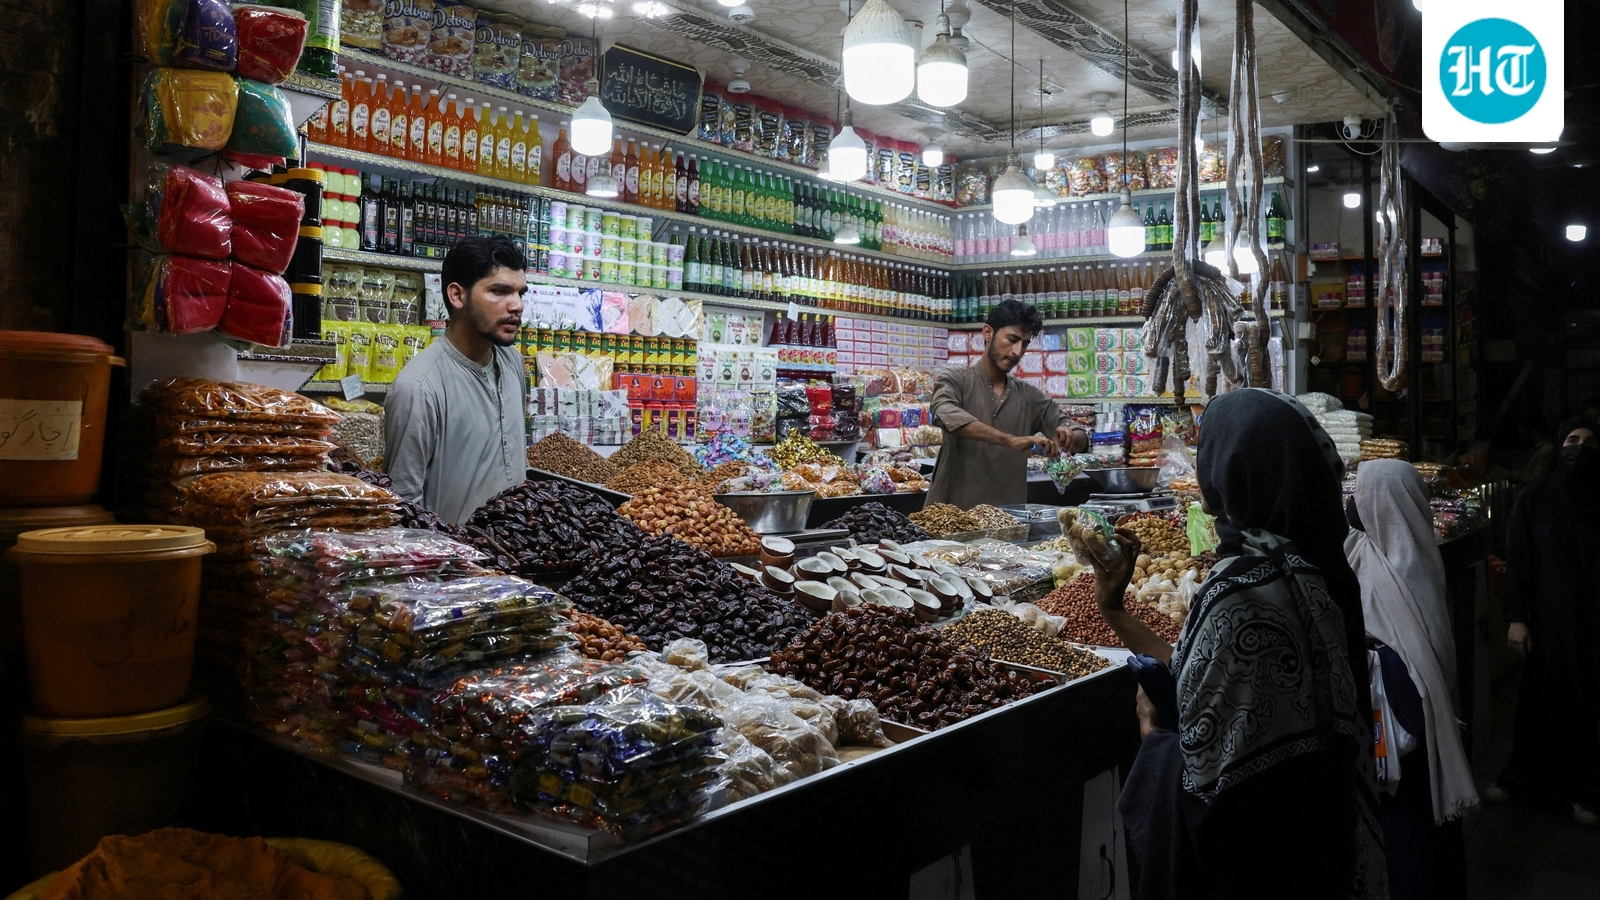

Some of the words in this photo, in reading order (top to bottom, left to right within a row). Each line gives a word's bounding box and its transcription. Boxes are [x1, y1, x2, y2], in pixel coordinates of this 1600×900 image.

[476, 27, 519, 47] Delvar
[521, 41, 559, 60] Delvar
[20, 421, 73, 450] اچار
